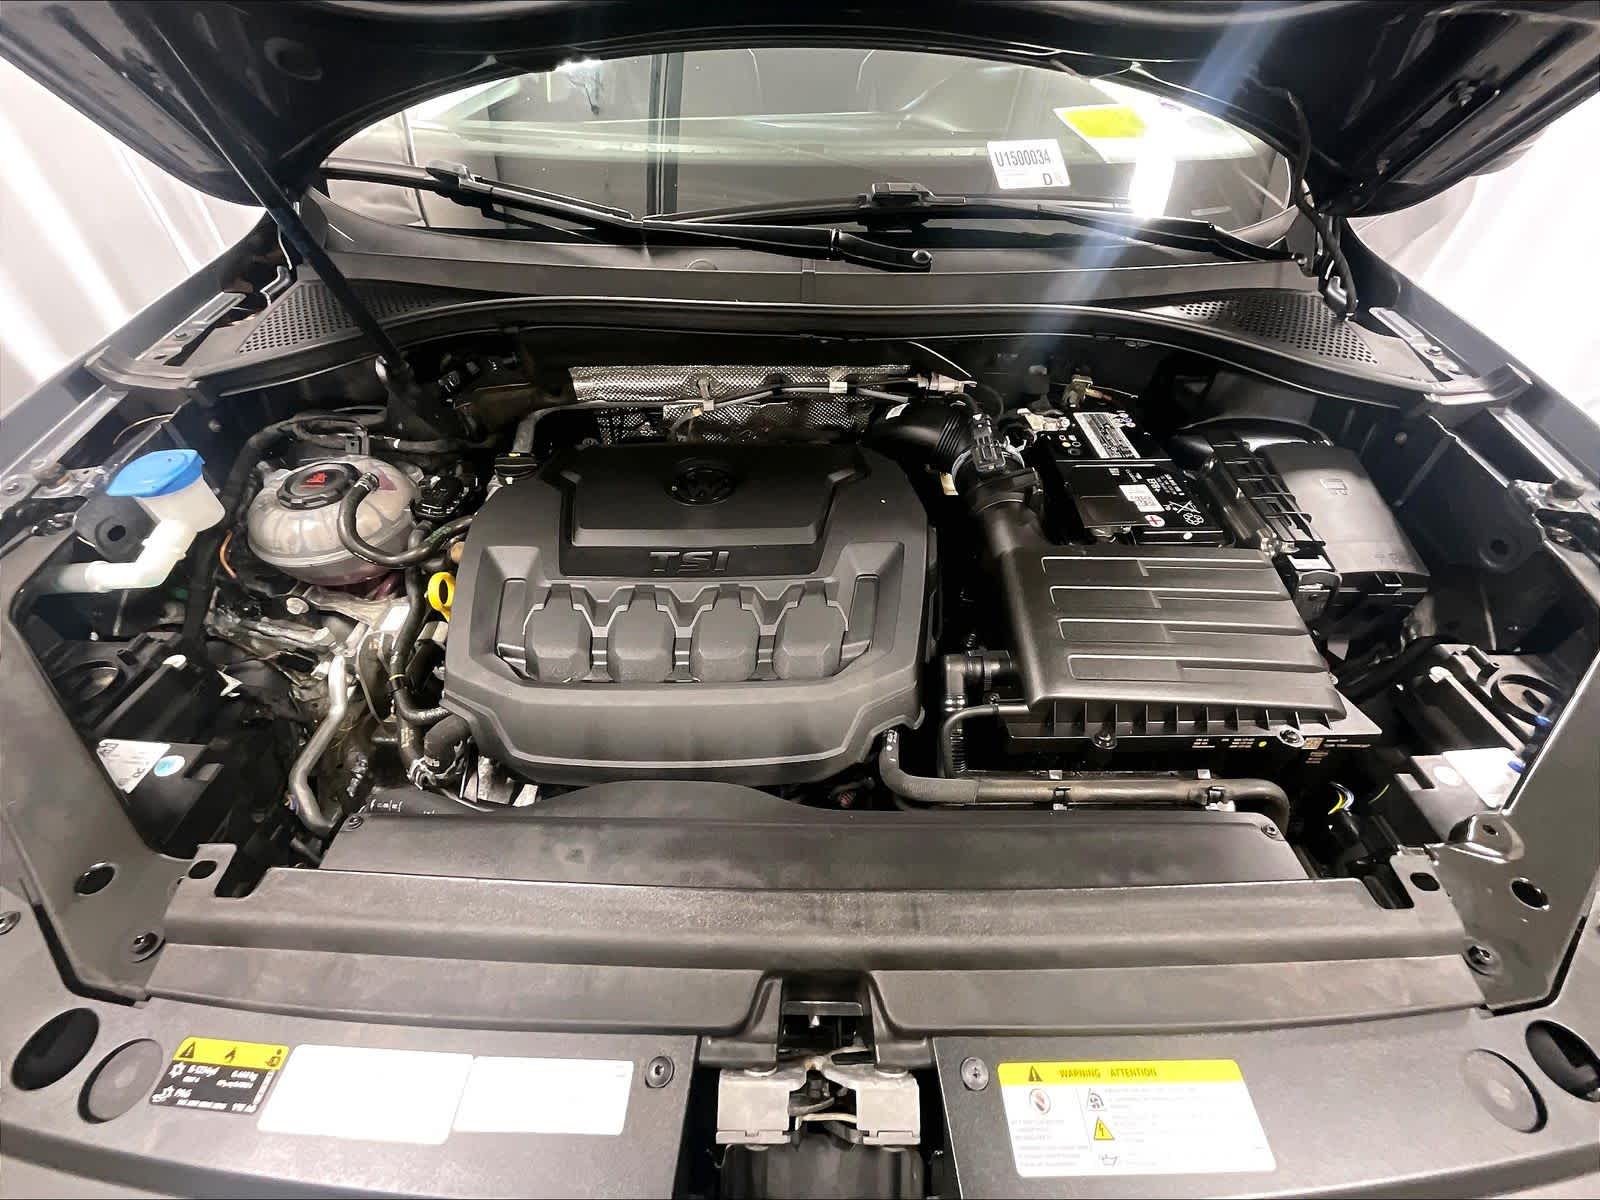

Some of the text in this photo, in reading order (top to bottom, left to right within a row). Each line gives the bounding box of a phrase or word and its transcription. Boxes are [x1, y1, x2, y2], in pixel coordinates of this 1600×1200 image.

[994, 148, 1051, 168] U1500034
[1042, 172, 1053, 186] D
[650, 551, 730, 572] TSI
[1059, 1067, 1157, 1078] WARNING ATTENTION
